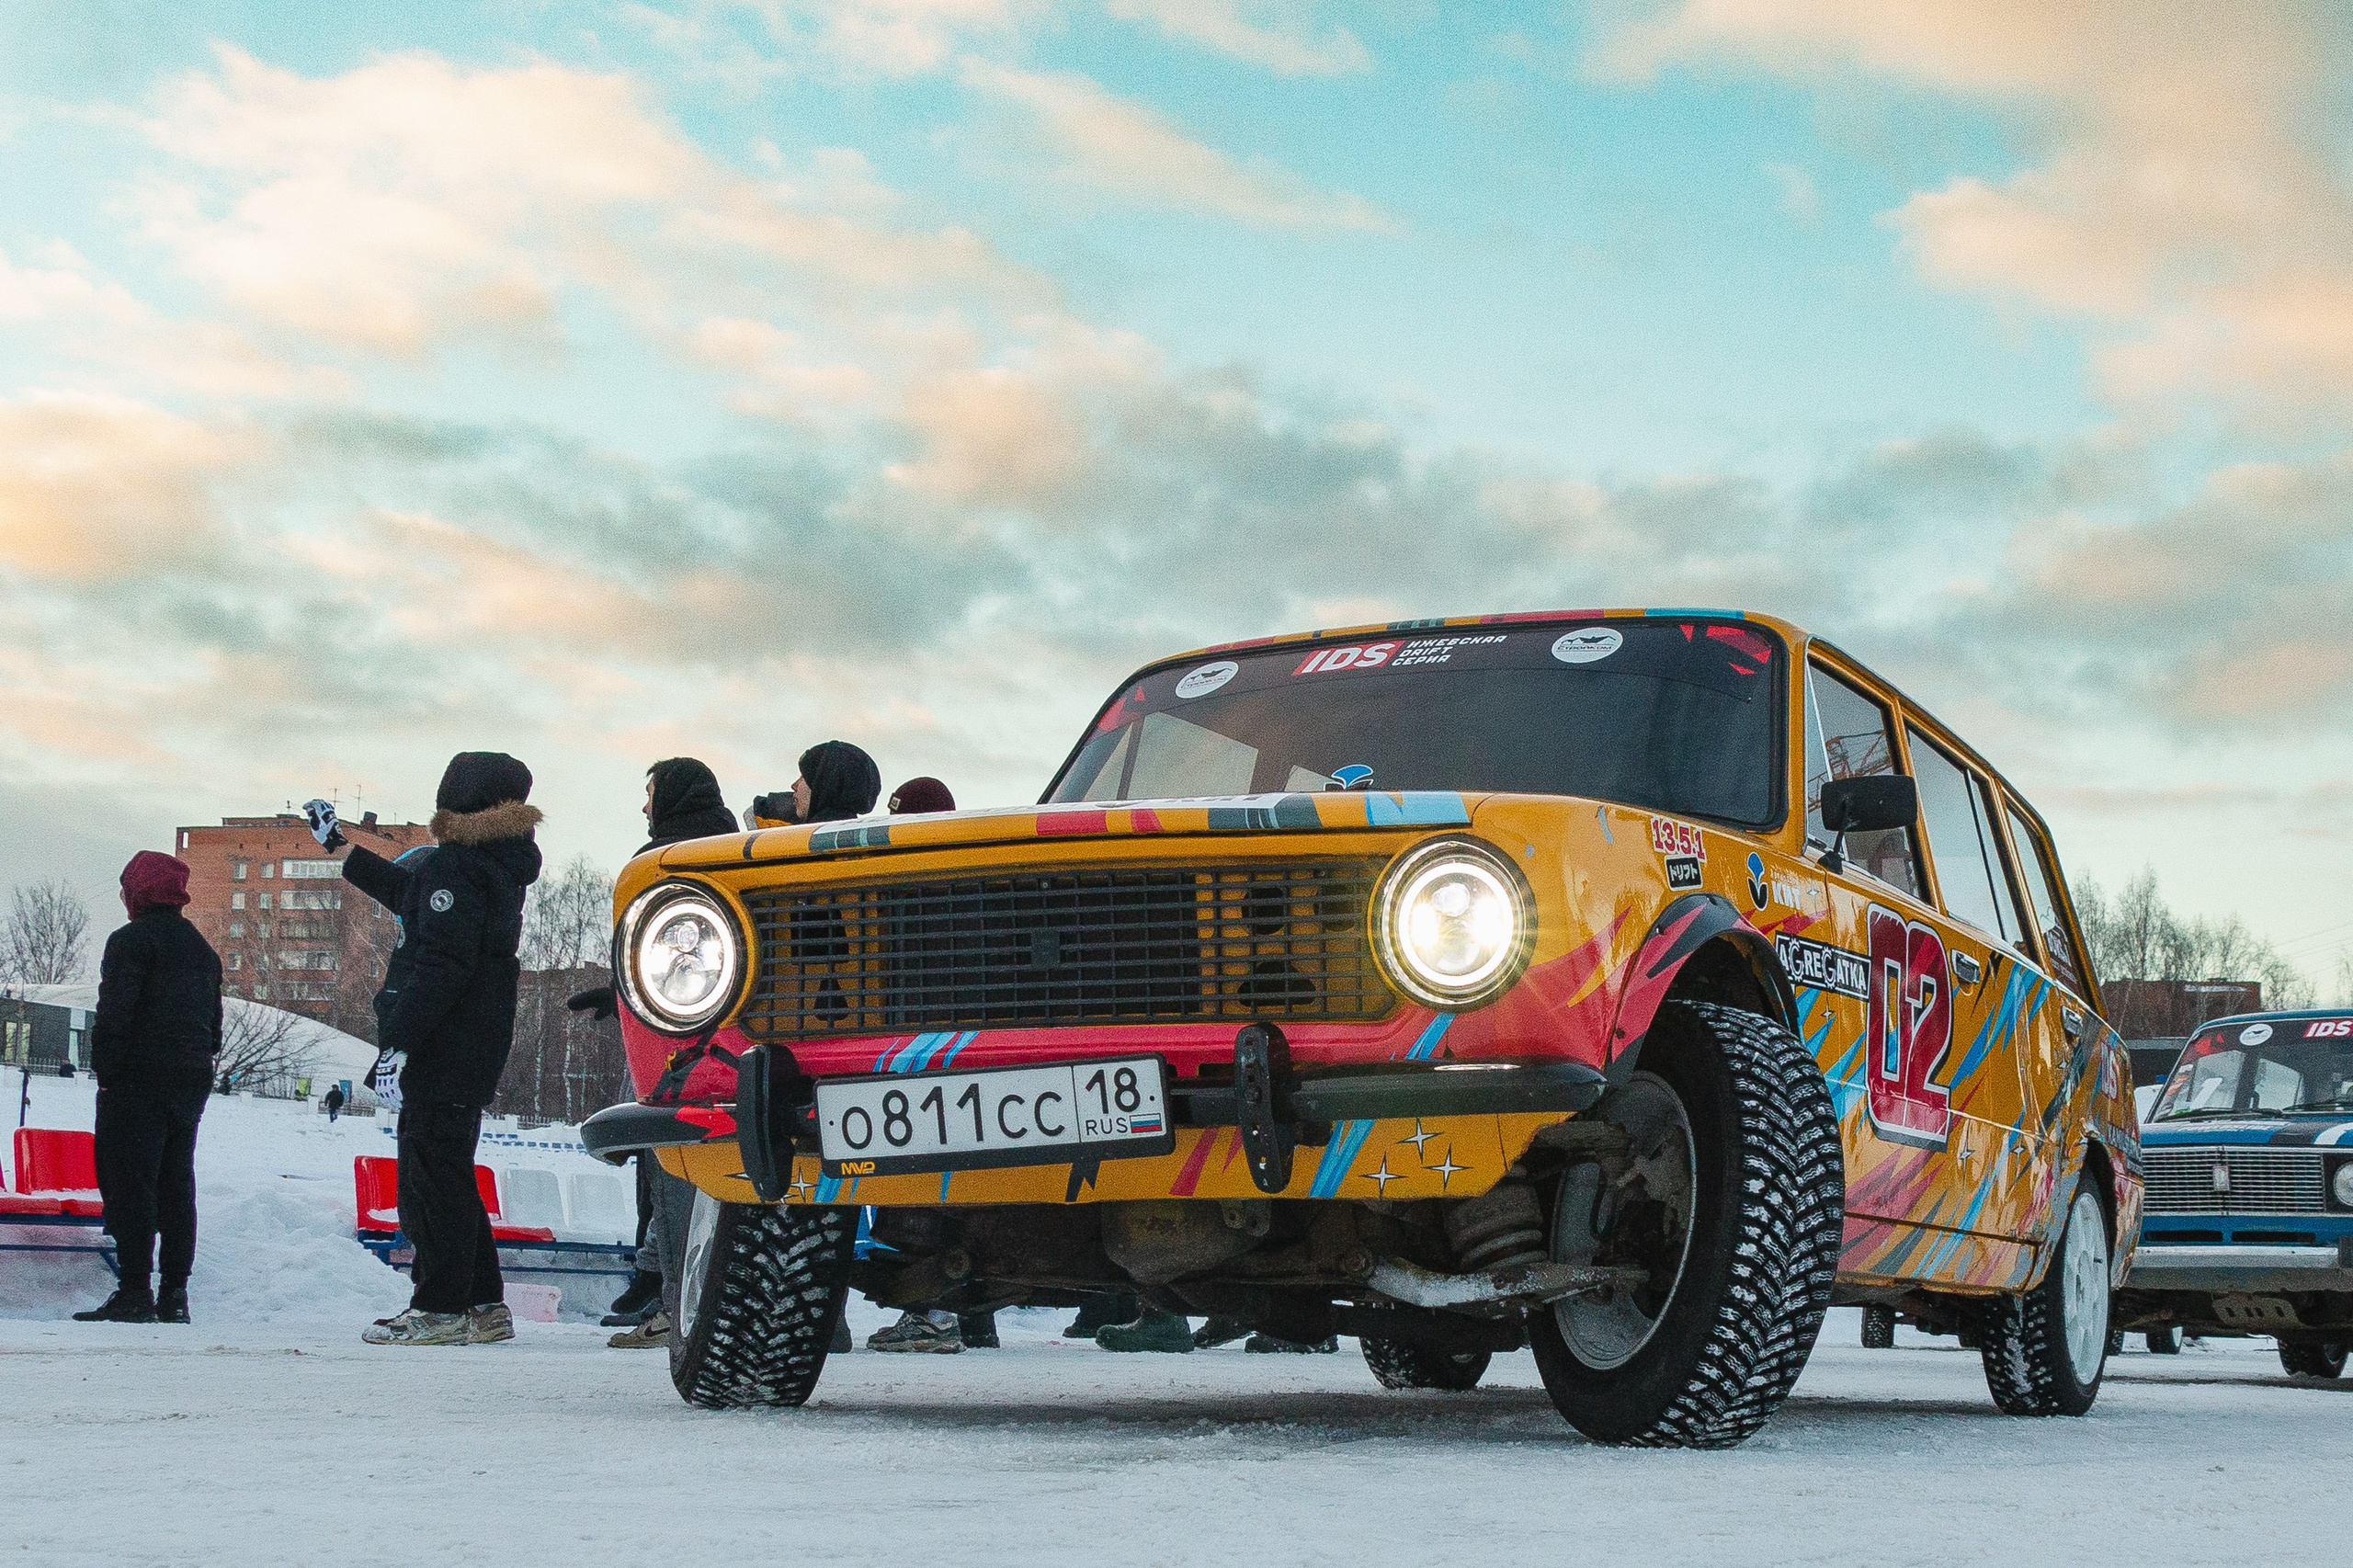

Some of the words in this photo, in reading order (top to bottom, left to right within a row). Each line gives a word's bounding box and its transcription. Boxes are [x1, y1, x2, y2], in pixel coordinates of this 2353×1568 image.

[1399, 646, 1453, 657] DRIFT
[1406, 635, 1508, 649] ИЖЕВСКАЯ
[1302, 643, 1396, 674] IDS
[1392, 654, 1451, 666] СЕРИЯ
[1653, 820, 1705, 859] 13.5.1
[1669, 863, 1698, 881] ドリフト
[1779, 938, 1867, 991] AGREGATKA
[1867, 903, 1951, 1144] 02
[2306, 1020, 2353, 1038] IDS
[1086, 1067, 1142, 1114] 18
[1086, 1117, 1128, 1136] RUS
